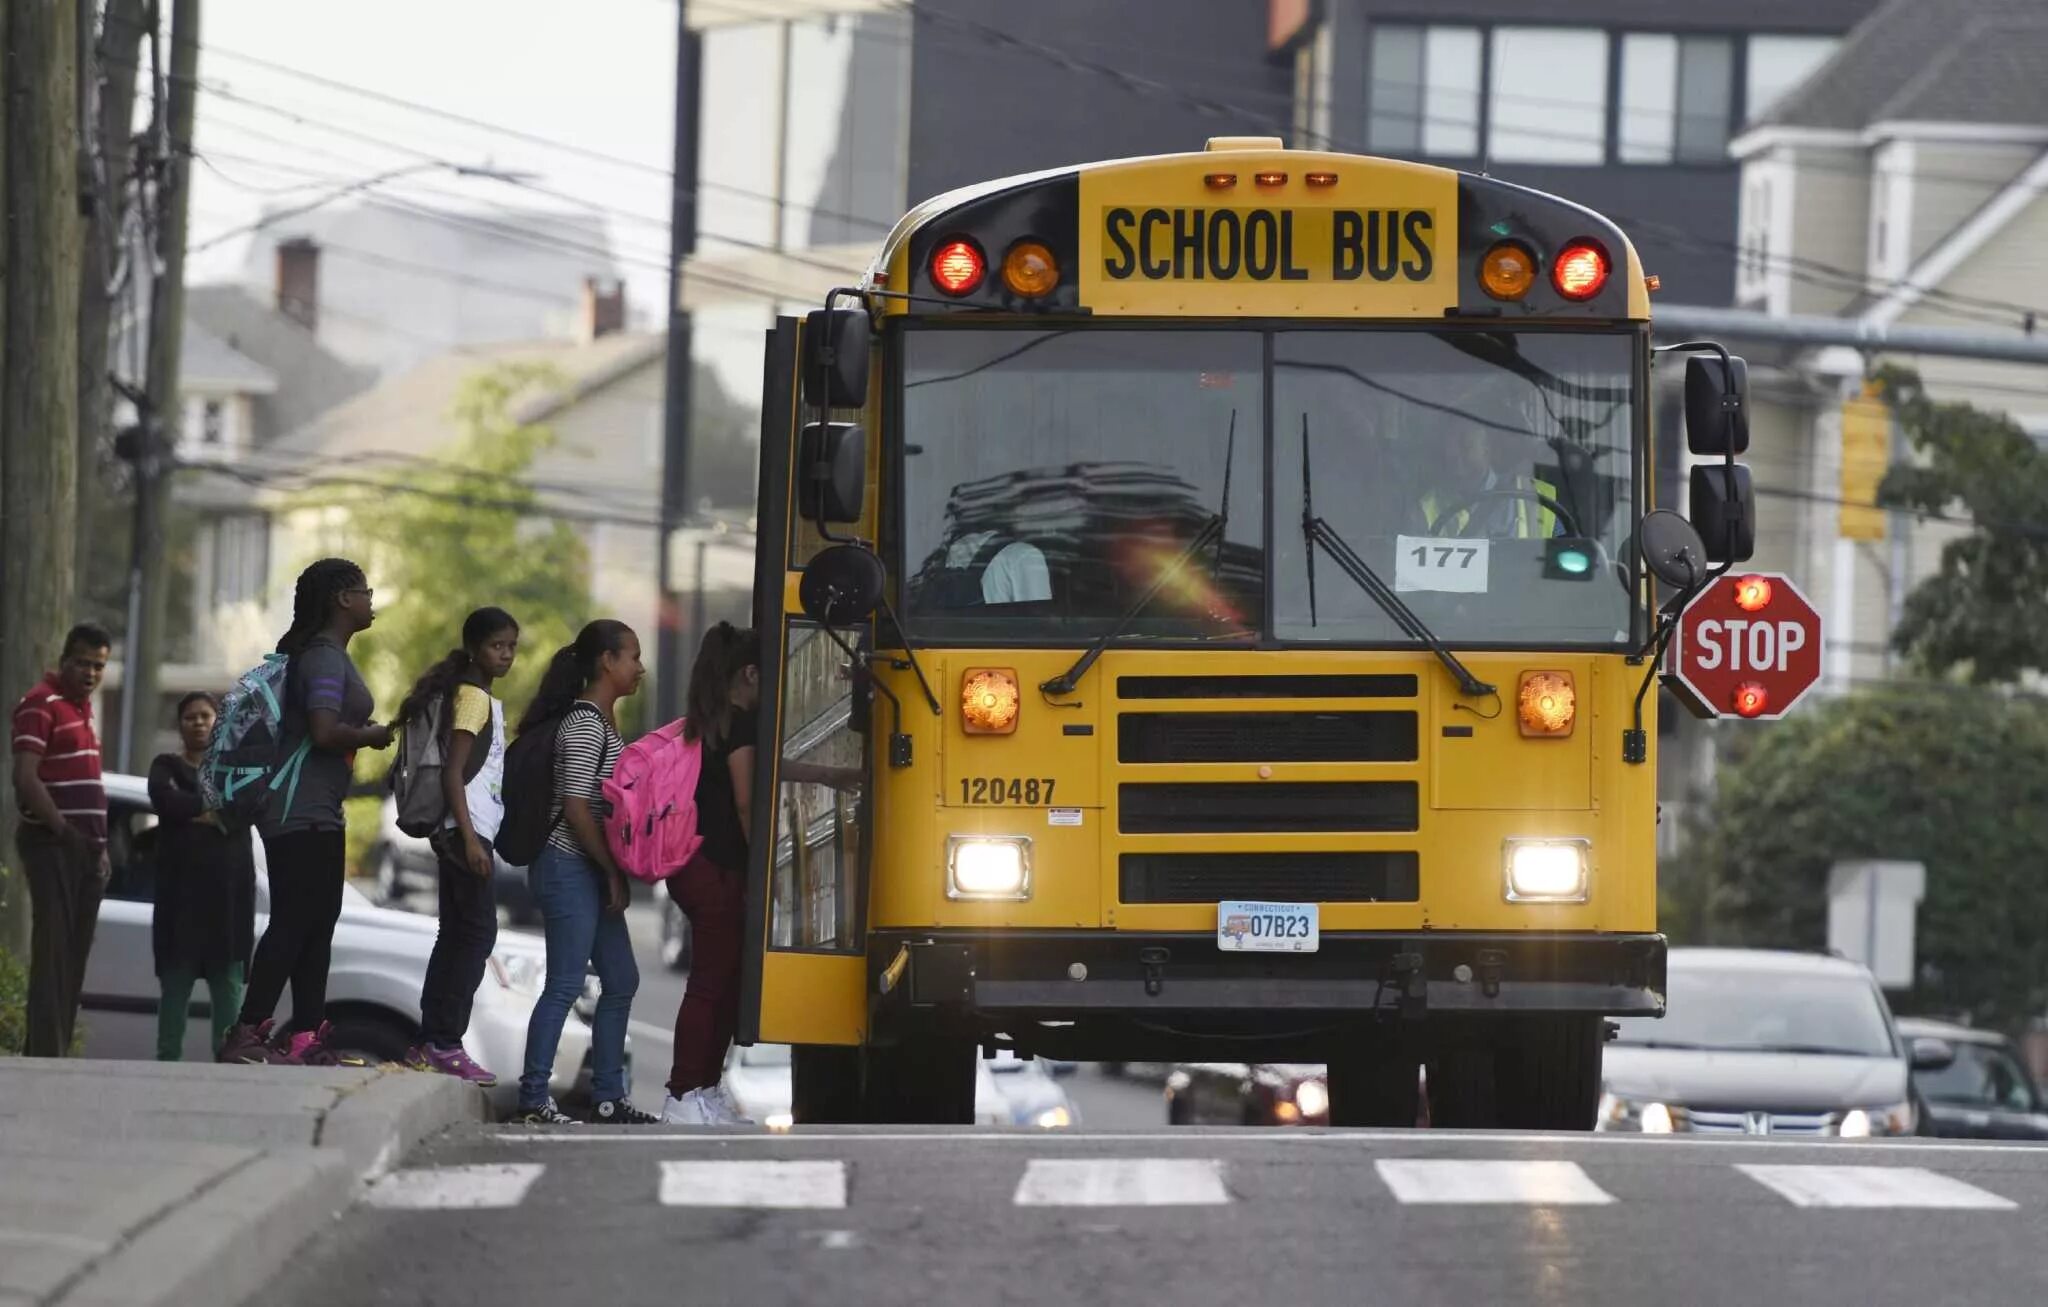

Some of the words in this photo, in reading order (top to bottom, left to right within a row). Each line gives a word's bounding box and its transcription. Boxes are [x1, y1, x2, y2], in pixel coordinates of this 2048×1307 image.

[1104, 208, 1309, 281] SCHOOL
[1332, 211, 1433, 281] BUS
[1411, 546, 1478, 569] 177
[1696, 619, 1806, 671] STOP
[960, 778, 1056, 804] 120487
[1251, 915, 1309, 938] 07B23
